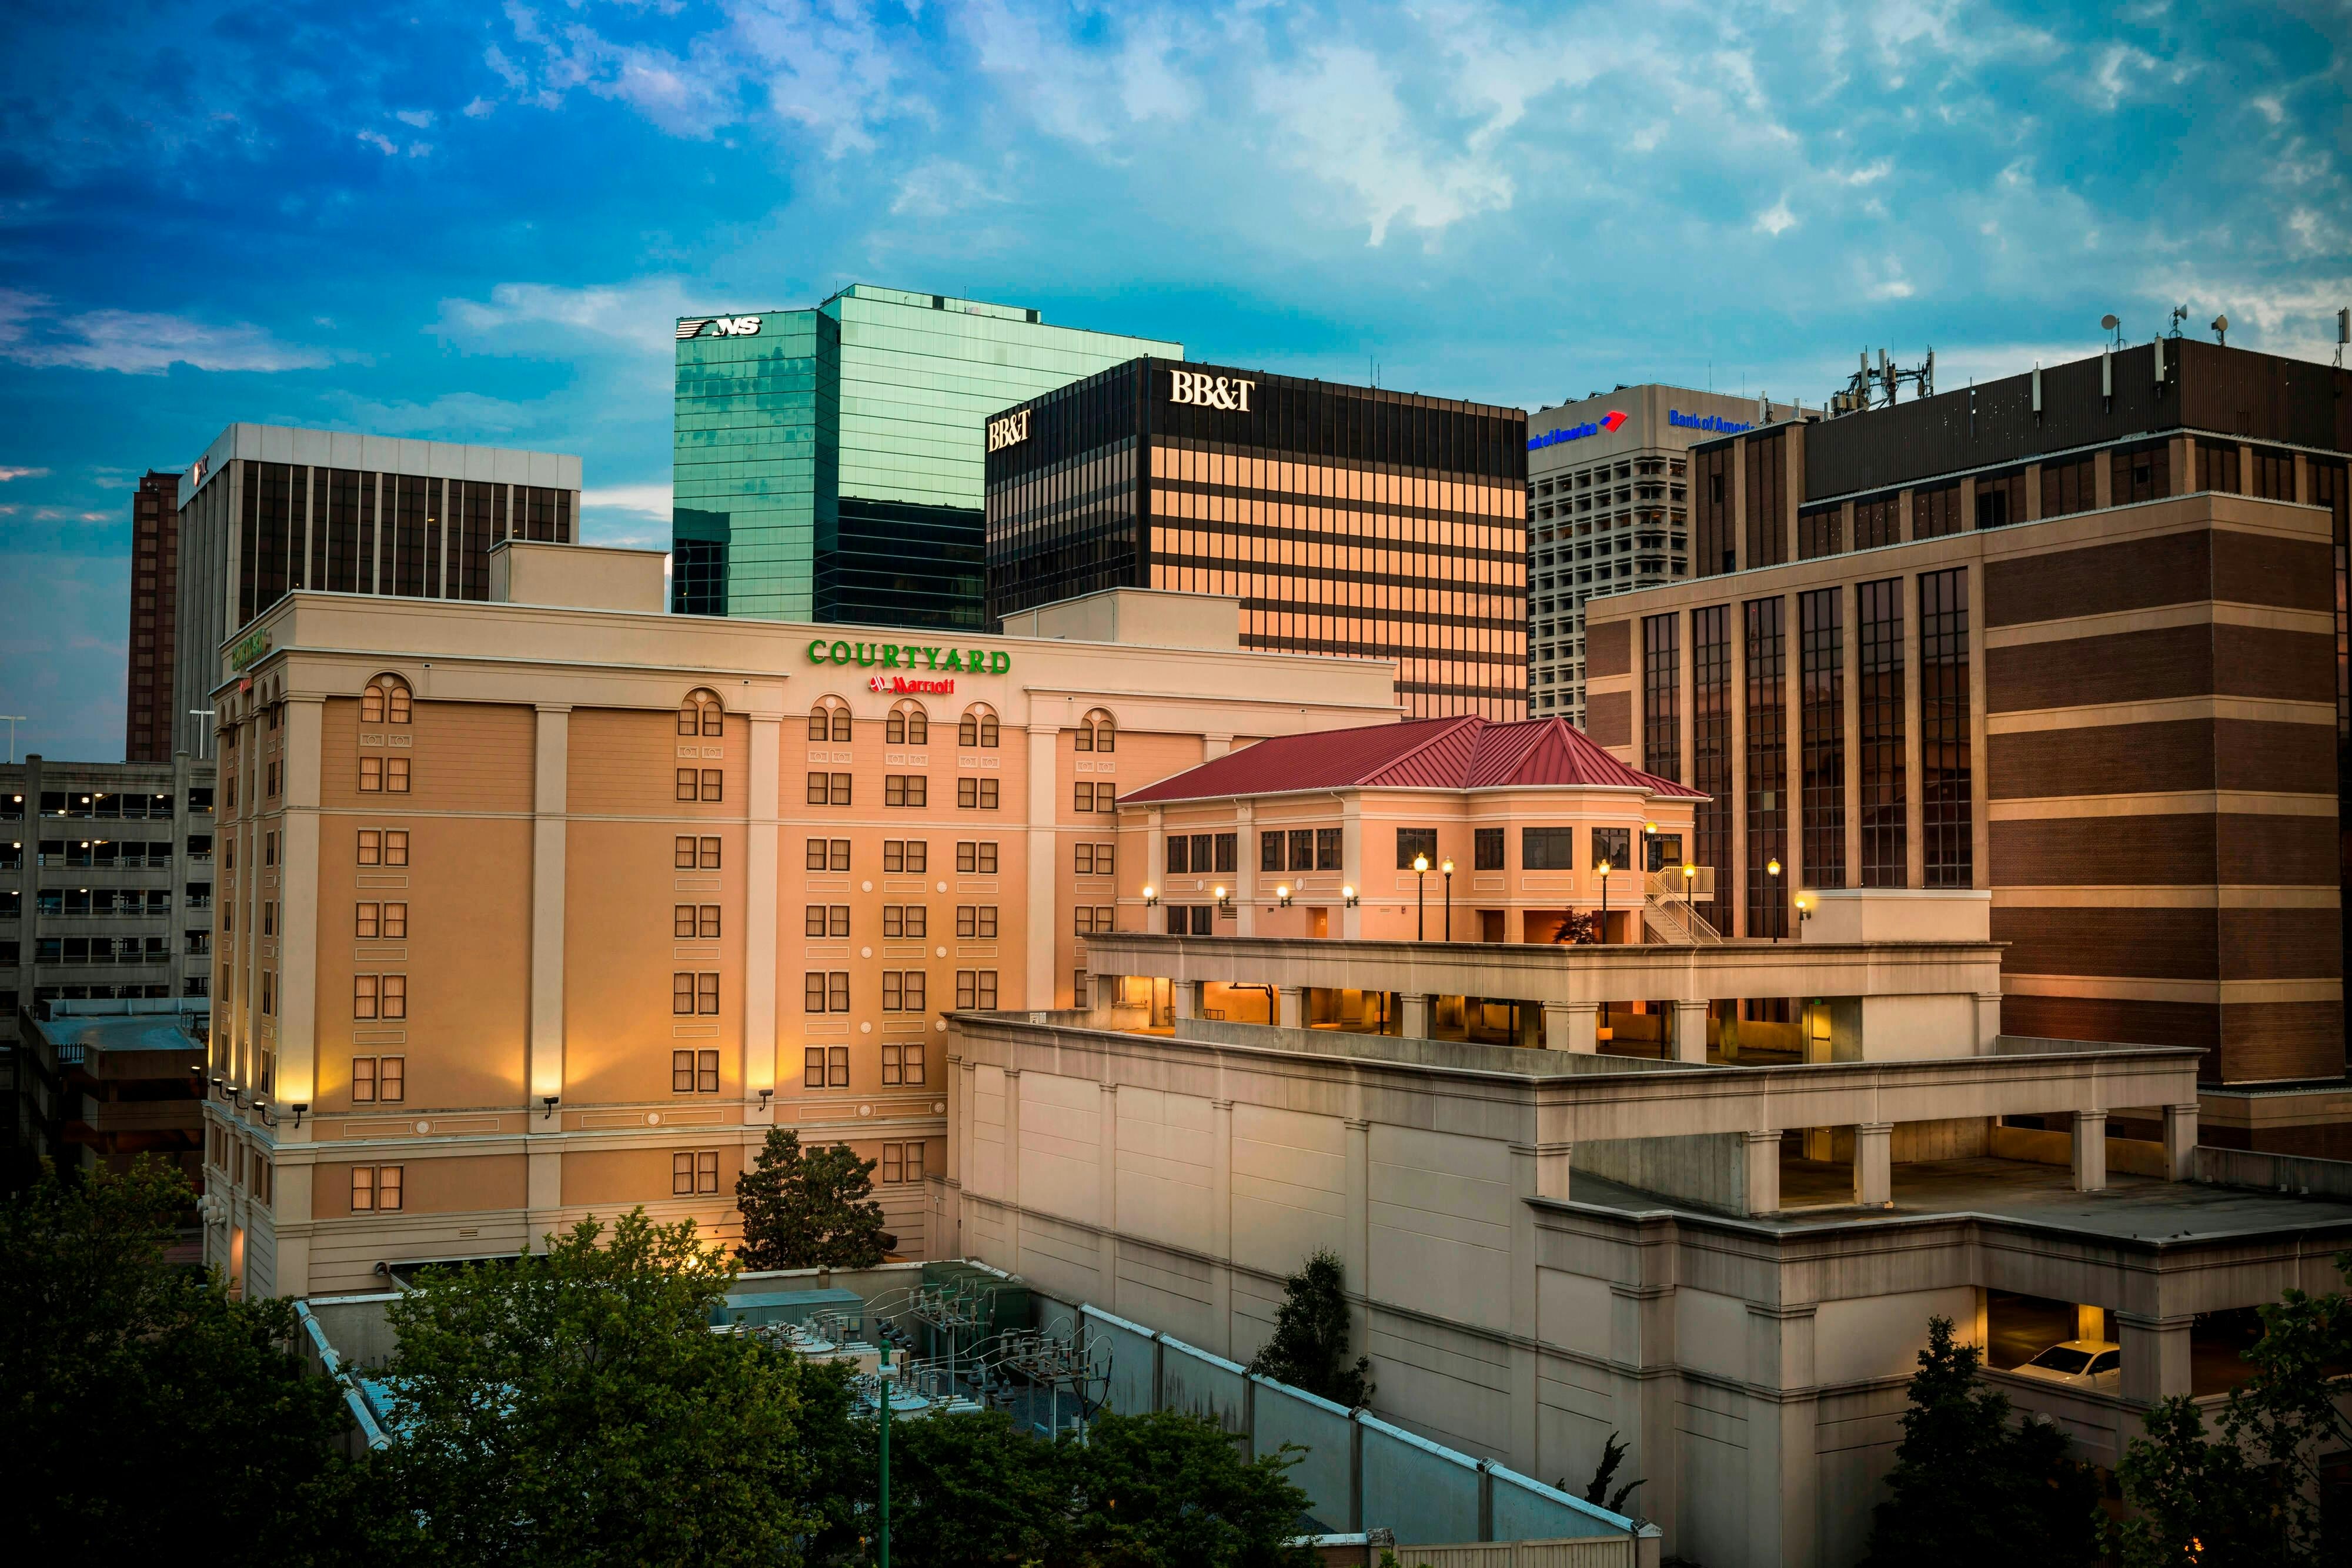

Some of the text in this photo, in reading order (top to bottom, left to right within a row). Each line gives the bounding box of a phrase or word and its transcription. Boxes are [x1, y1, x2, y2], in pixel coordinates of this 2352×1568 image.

[712, 317, 760, 336] NS
[1170, 369, 1255, 412] BB&T
[988, 409, 1031, 453] BB&T
[1669, 410, 1700, 429] Bank
[1701, 415, 1715, 432] of
[1543, 430, 1553, 447] of
[1554, 422, 1597, 444] America
[808, 640, 1011, 674] COURTYARD
[887, 676, 954, 694] Marriott
